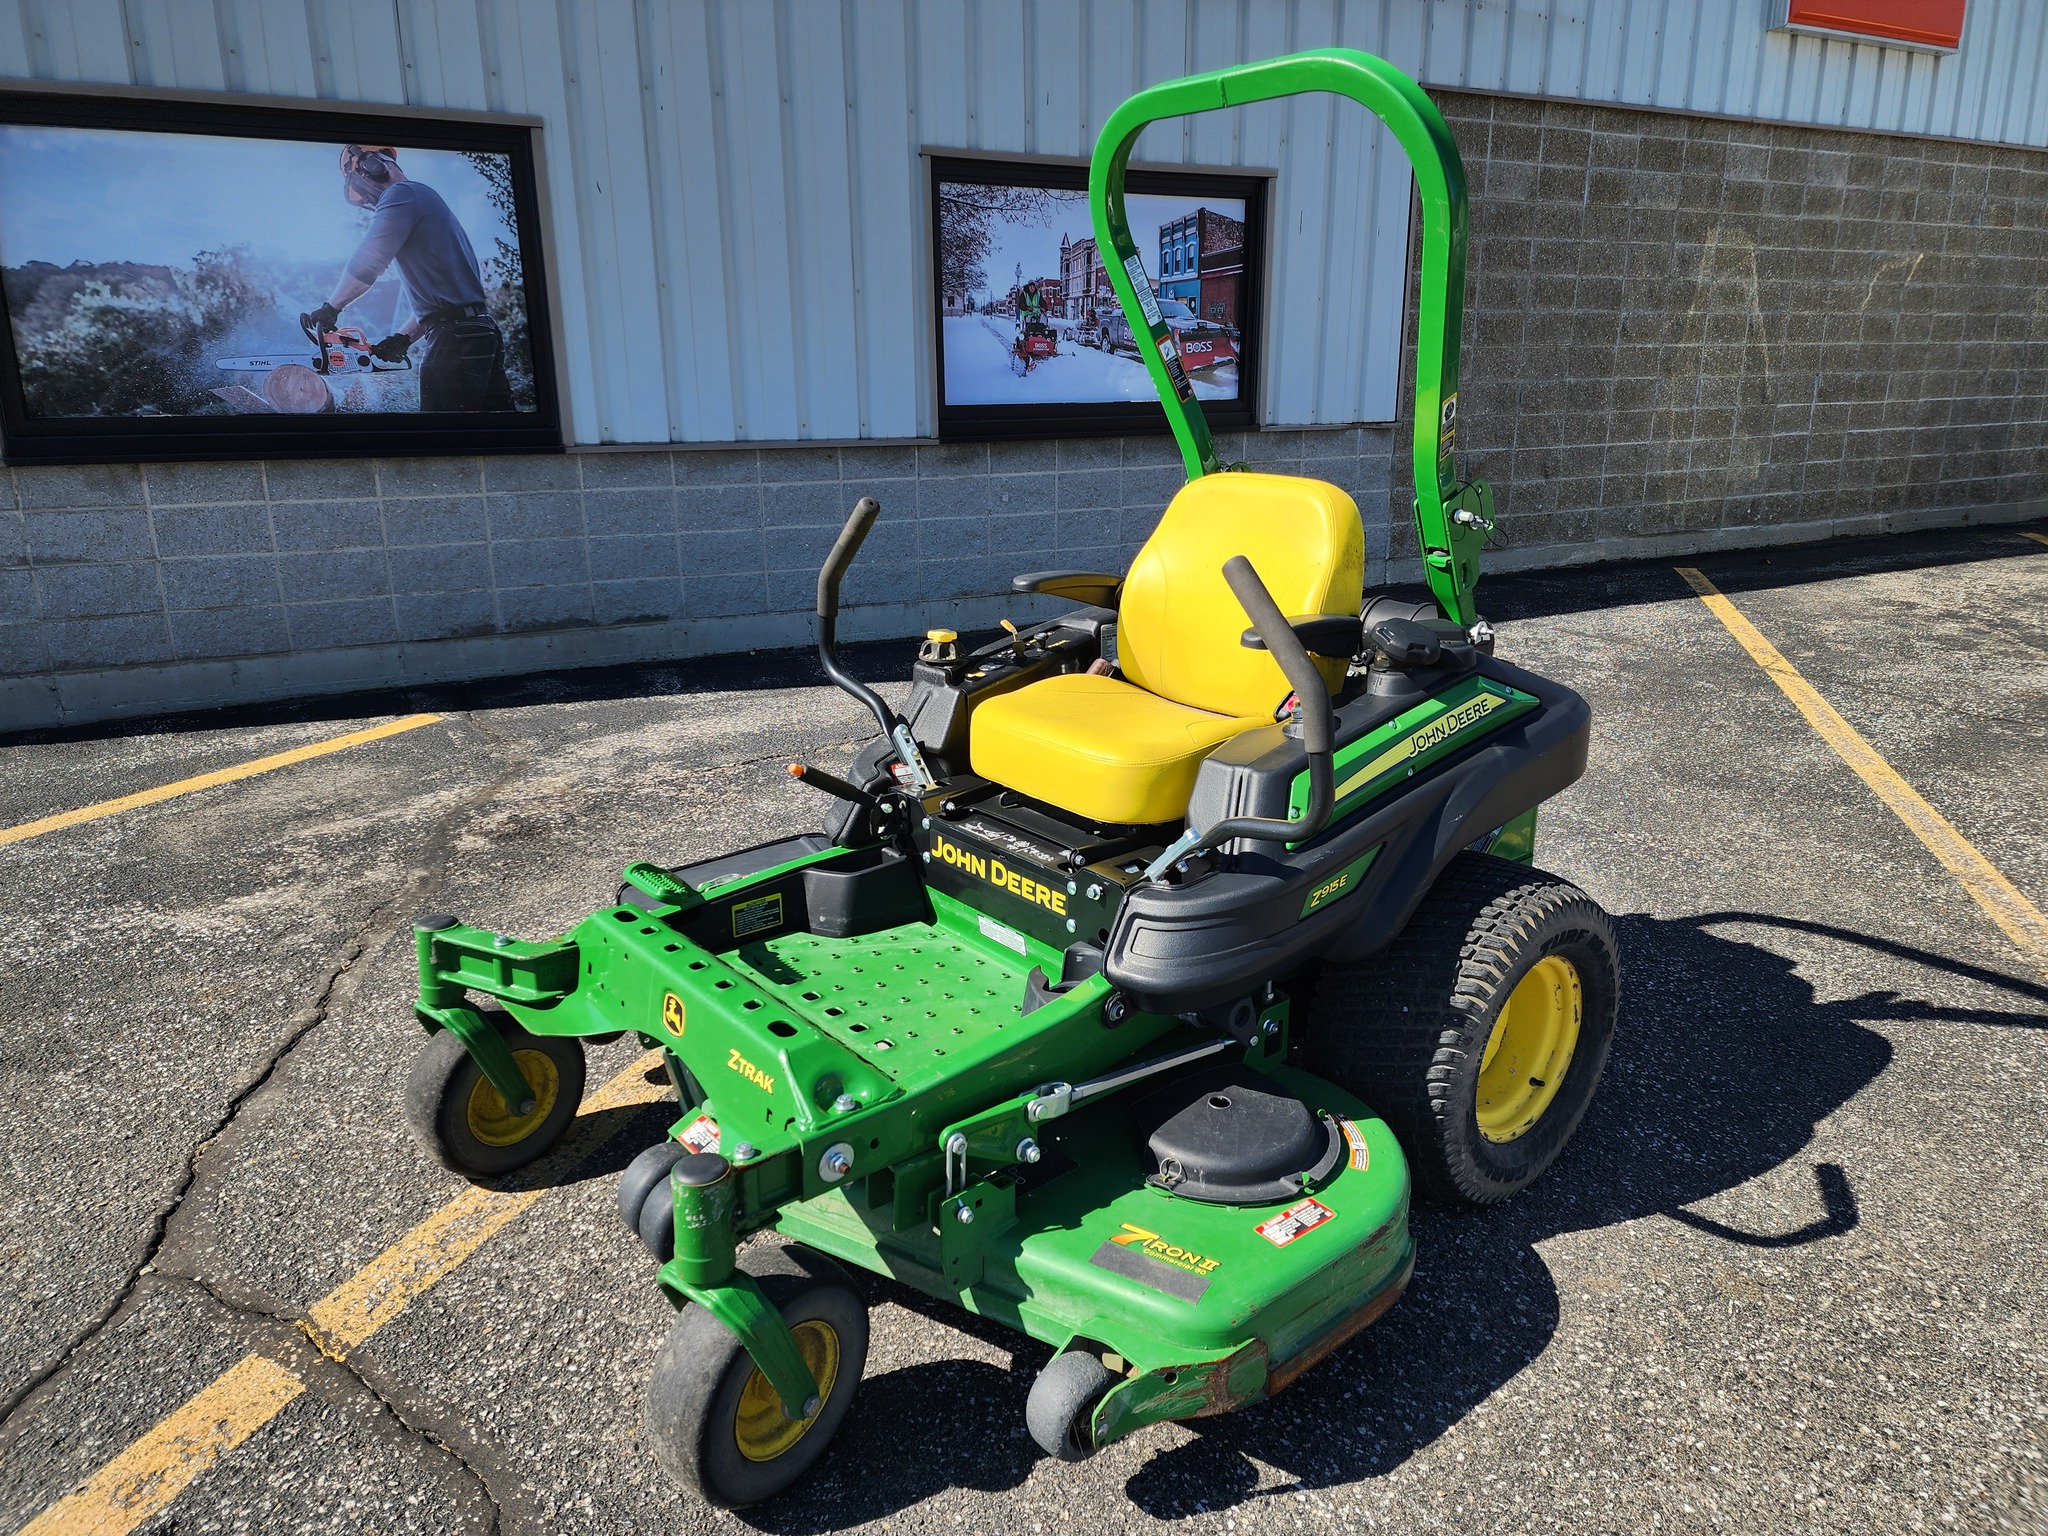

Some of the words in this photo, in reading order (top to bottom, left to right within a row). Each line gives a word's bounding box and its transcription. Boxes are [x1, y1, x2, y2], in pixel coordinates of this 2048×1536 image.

[1185, 341, 1213, 354] BOSS
[1409, 723, 1447, 756] JOHN
[1446, 698, 1491, 732] DEERE
[931, 835, 986, 879] JOHN
[991, 858, 1067, 917] DEERE
[1309, 873, 1349, 908] Z915E
[1540, 928, 1590, 957] TURF
[727, 1048, 776, 1095] ZTRAK
[1142, 1248, 1194, 1271] Commercial
[1198, 1258, 1222, 1272] II
